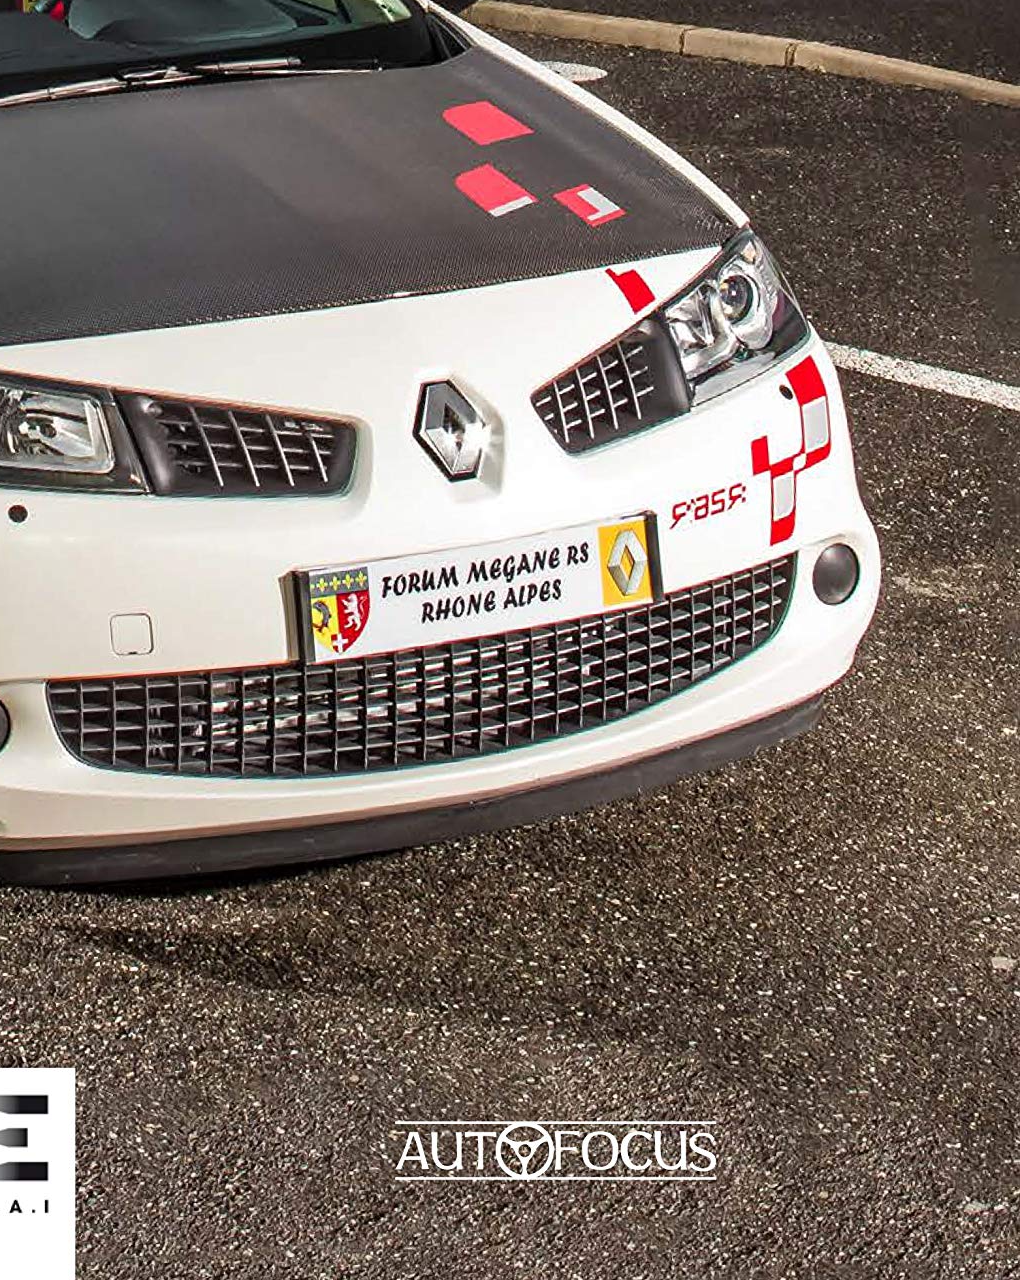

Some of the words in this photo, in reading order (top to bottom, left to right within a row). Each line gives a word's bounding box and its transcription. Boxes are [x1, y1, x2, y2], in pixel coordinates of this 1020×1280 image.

[382, 565, 459, 599] FORUM
[466, 547, 561, 584] MEGANE
[566, 542, 589, 566] RS
[421, 590, 496, 624] RHONE
[503, 579, 563, 610] ALPES
